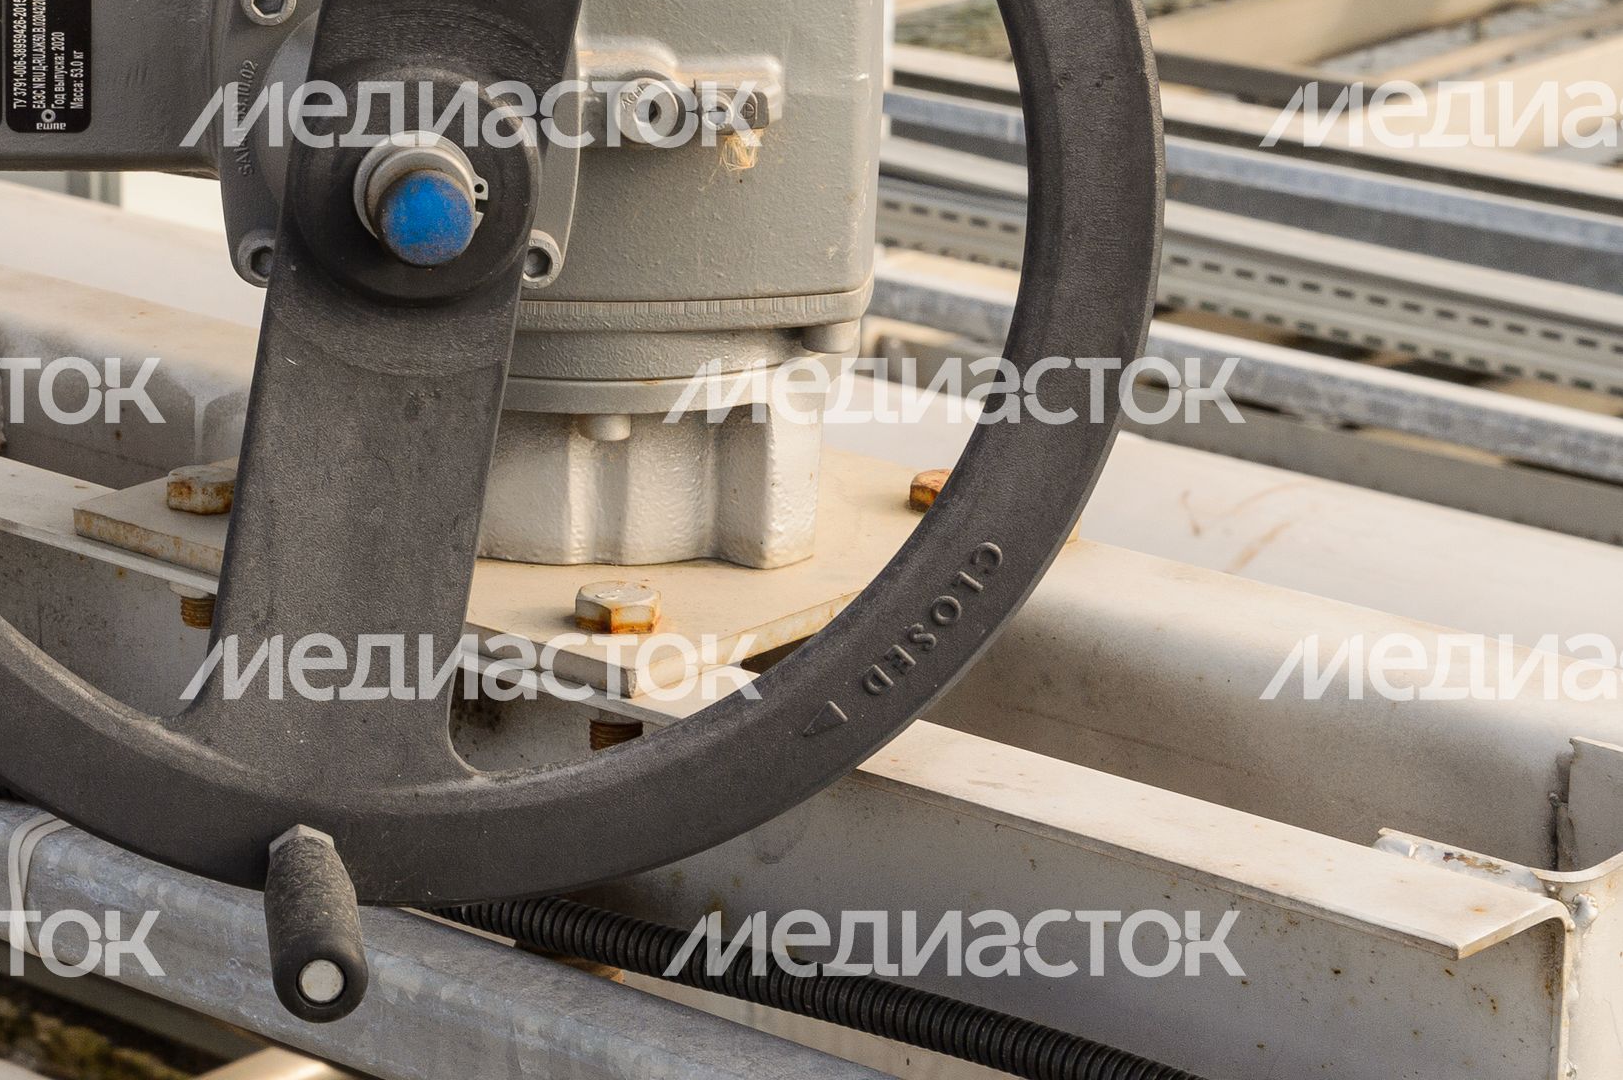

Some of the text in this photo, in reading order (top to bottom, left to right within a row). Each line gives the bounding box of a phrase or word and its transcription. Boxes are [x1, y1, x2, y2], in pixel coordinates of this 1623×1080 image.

[52, 32, 67, 109] Год выпуска: 2020
[71, 50, 84, 109] Масса: 53.0 кг
[14, 98, 27, 109] ТУ
[33, 90, 46, 109] ЕАЭС
[37, 122, 66, 130] auma
[863, 541, 1003, 696] CLOSED
